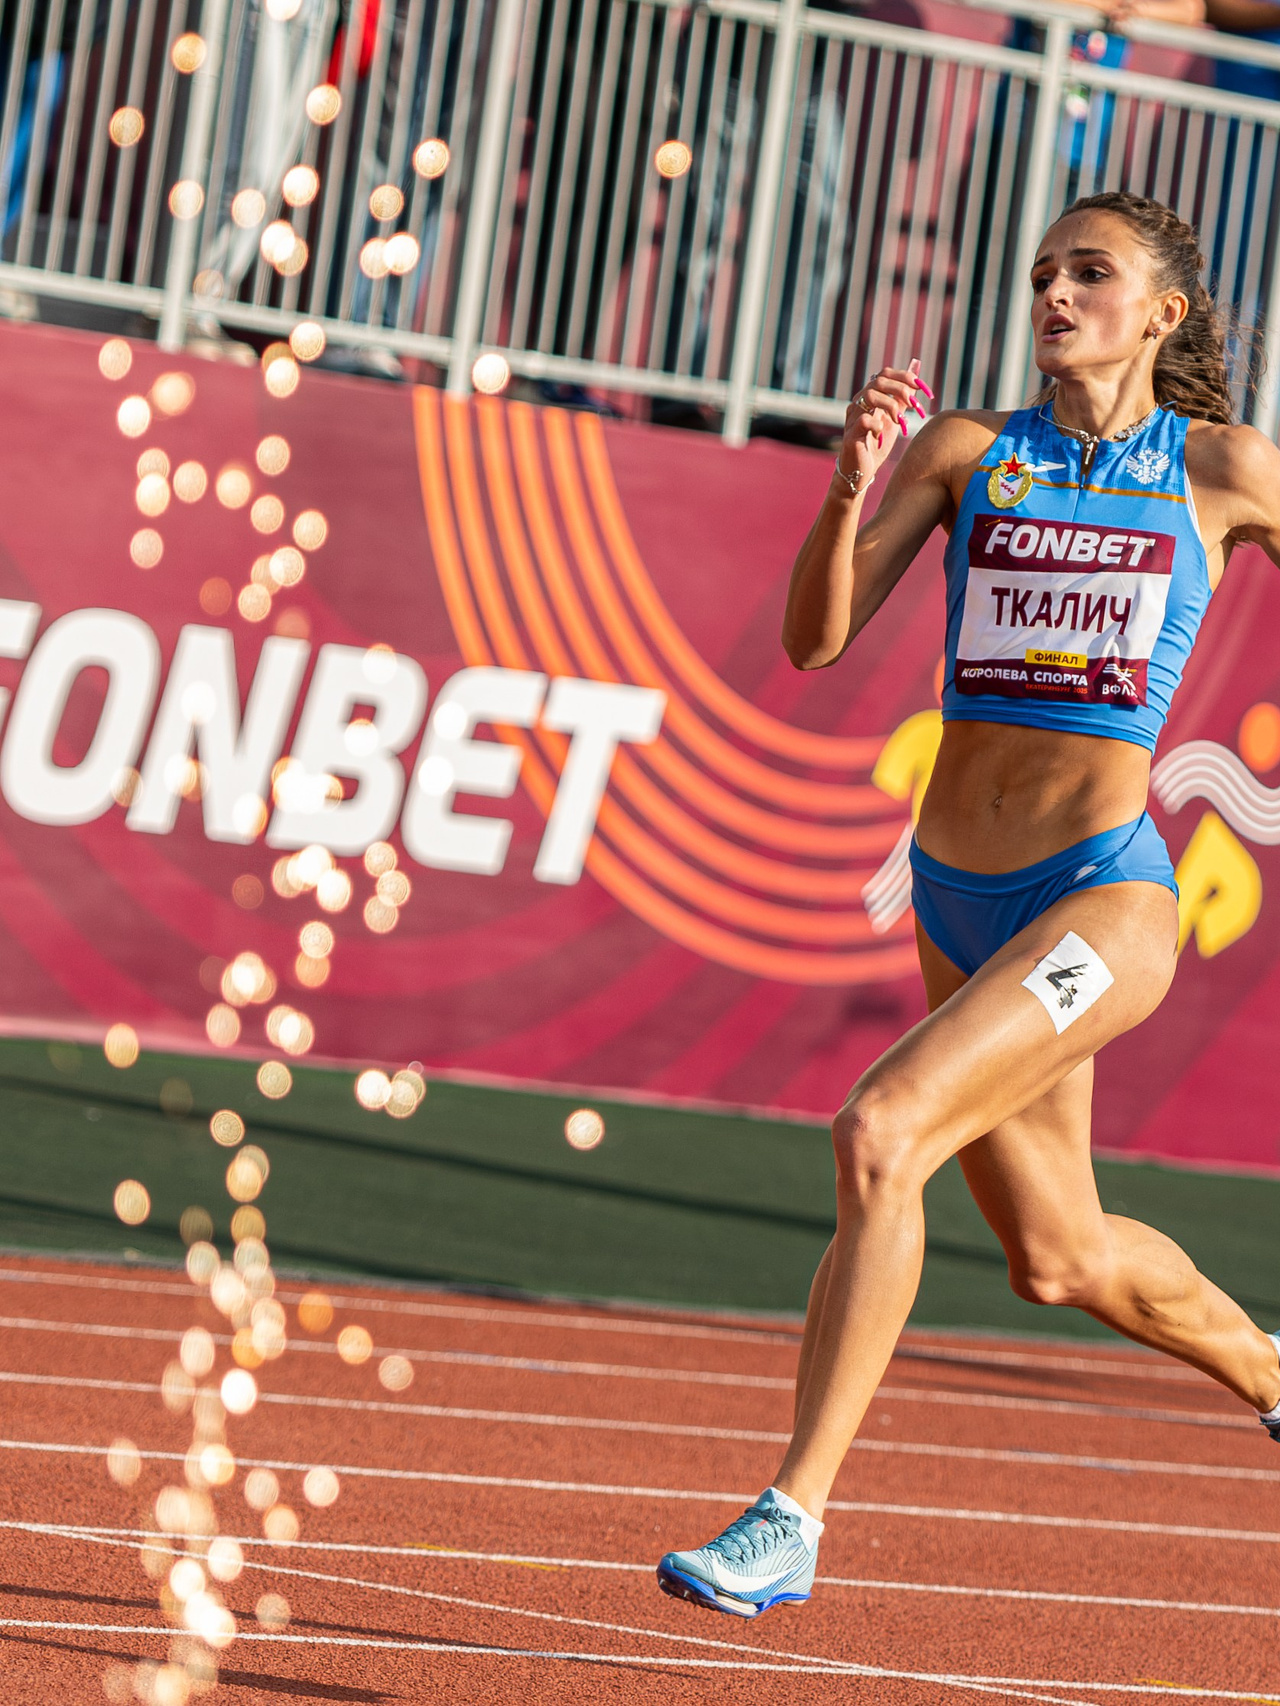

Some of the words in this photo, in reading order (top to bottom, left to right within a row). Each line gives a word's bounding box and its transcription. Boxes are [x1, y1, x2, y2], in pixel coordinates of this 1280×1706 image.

[984, 522, 1156, 567] FONBET
[990, 585, 1133, 636] ТКАЛИЧ
[1033, 651, 1079, 666] ФИНАЛ
[961, 667, 1029, 682] КОРОЛЕВА
[1033, 671, 1088, 686] СПОРТА
[1073, 686, 1088, 695] 2025
